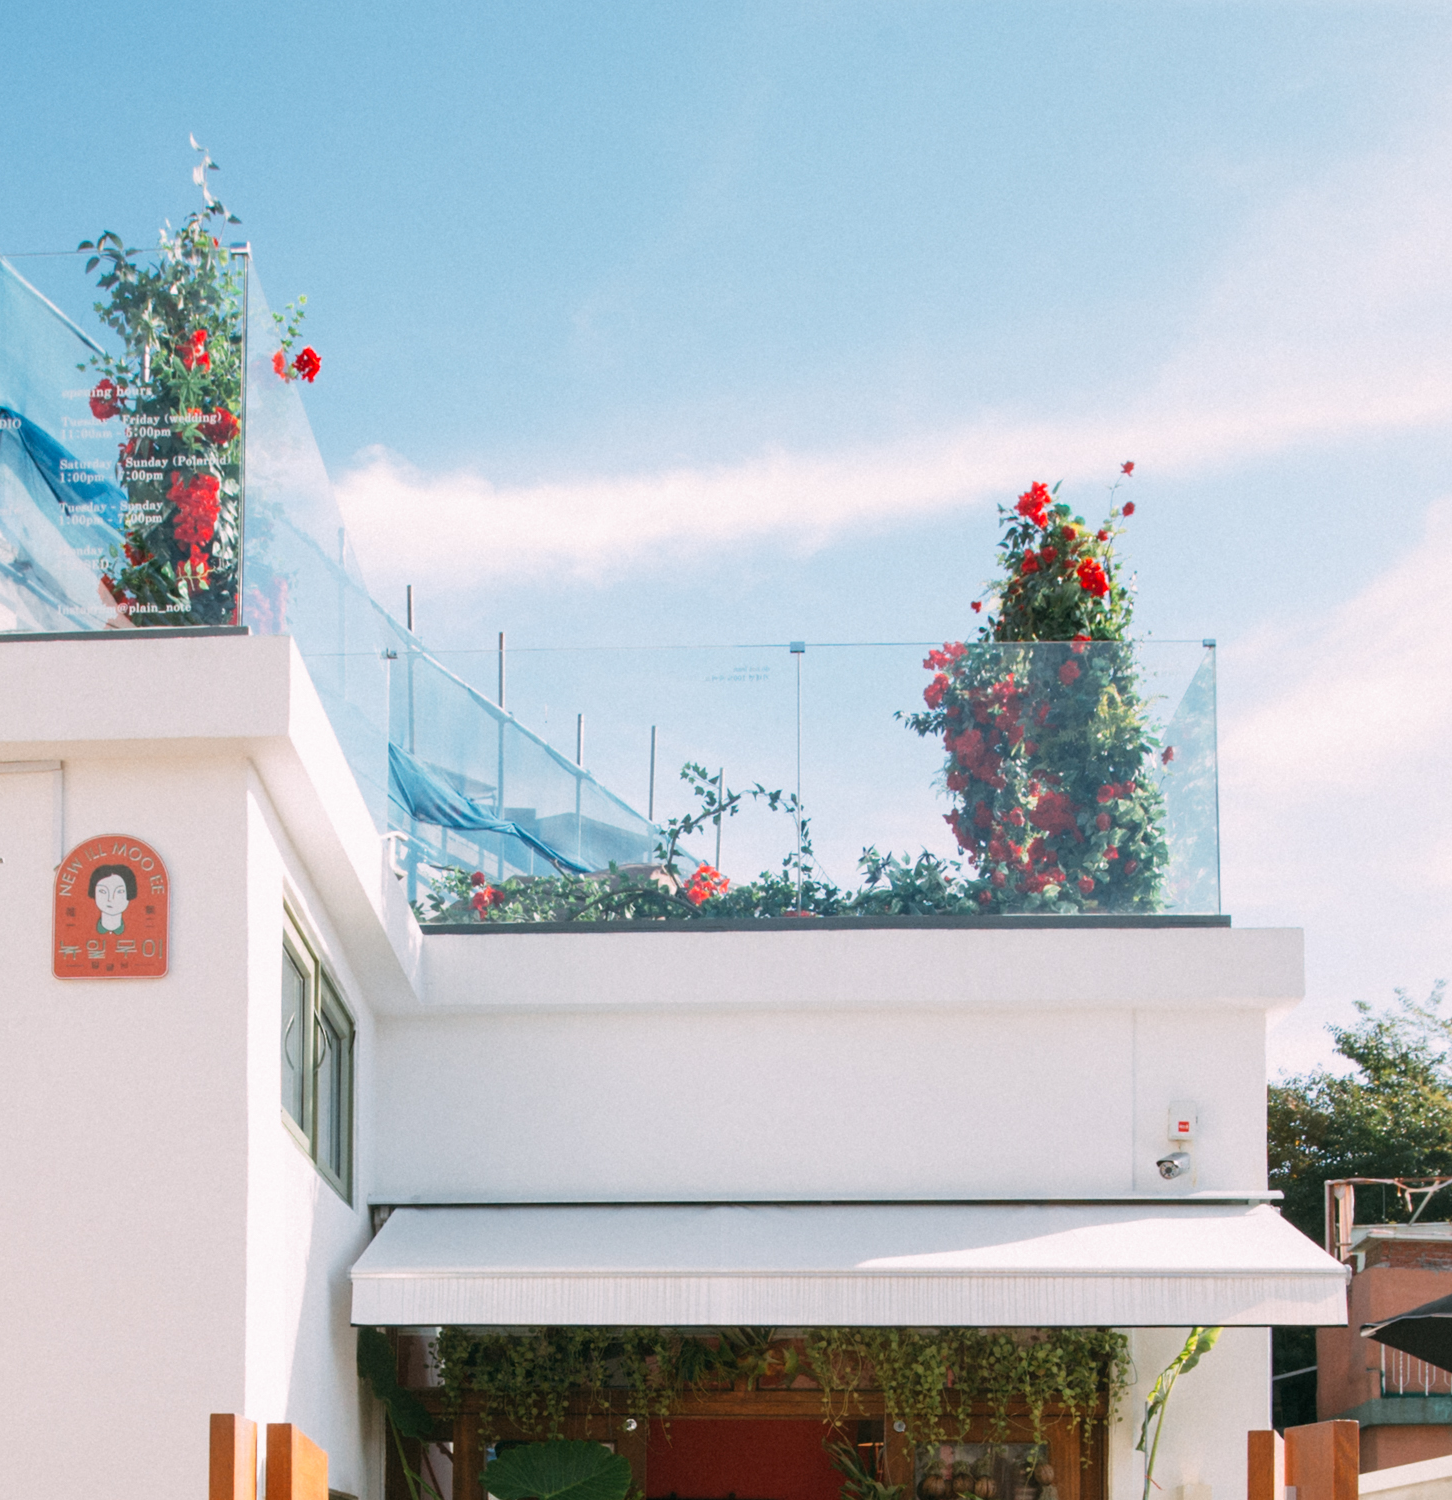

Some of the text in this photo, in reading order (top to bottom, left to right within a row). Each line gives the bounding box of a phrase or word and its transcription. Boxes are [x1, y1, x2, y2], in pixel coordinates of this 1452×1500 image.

[62, 385, 152, 399] opening hours
[61, 416, 107, 427] Tuesday
[122, 413, 160, 425] Friday
[164, 412, 222, 425] (wedding)
[60, 458, 111, 471] Saturday
[125, 457, 168, 469] Sunday
[60, 472, 104, 484] 1:00pm
[118, 470, 163, 482] 7:00pm
[59, 501, 107, 513] Tuesday
[119, 500, 163, 512] Sunday
[59, 515, 104, 527] 1:00pm
[118, 513, 163, 524] 7:00pm
[59, 843, 164, 897] NEW ILL MOO EE
